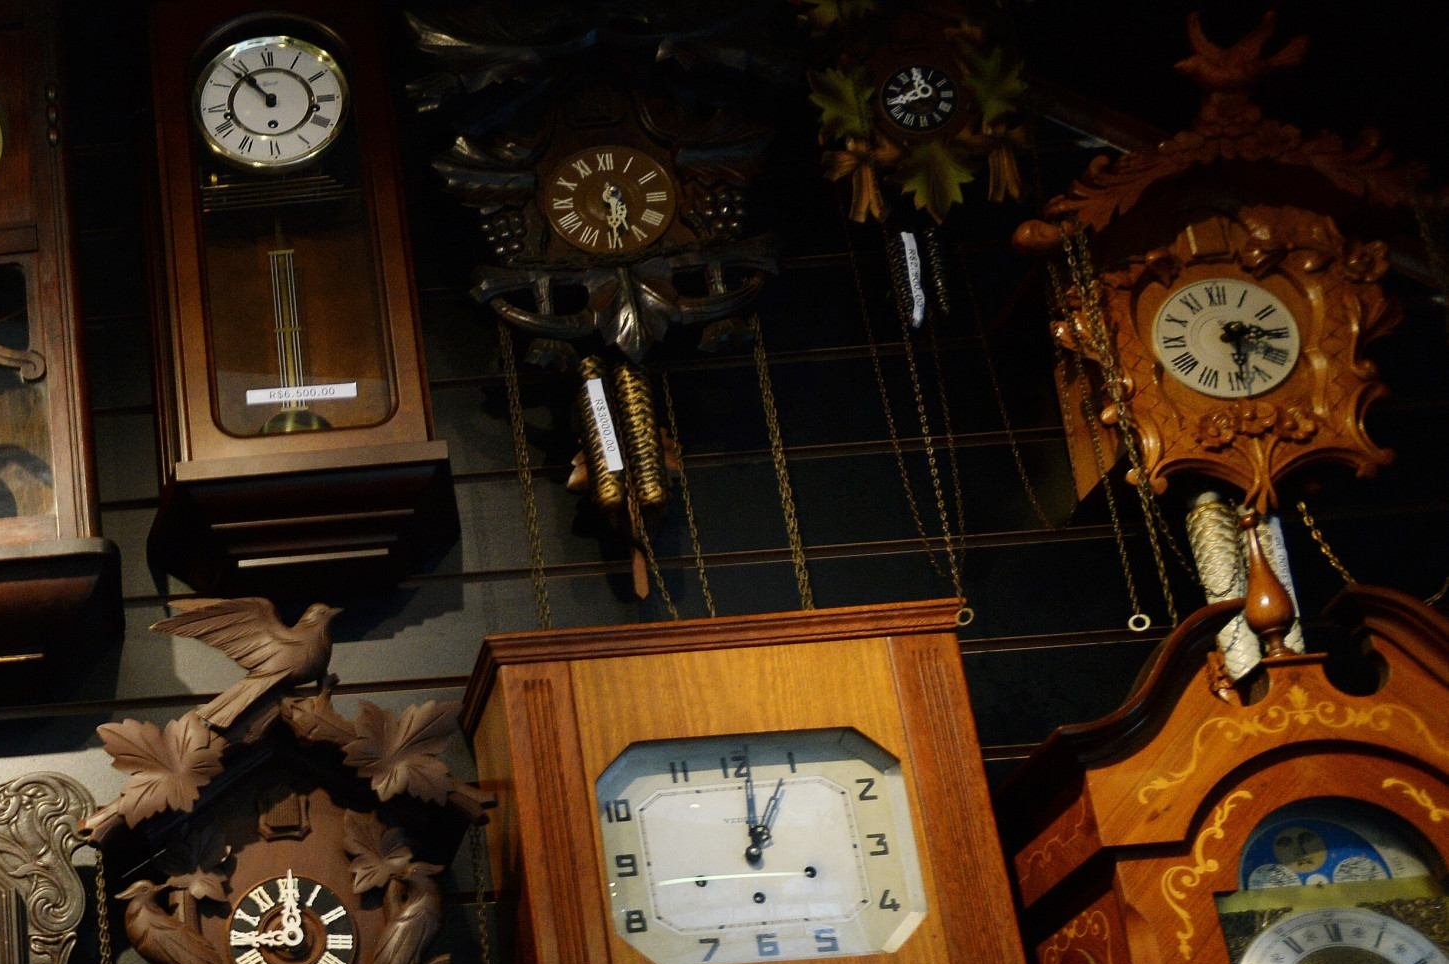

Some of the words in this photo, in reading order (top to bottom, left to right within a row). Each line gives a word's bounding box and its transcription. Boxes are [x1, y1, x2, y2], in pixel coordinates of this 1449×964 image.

[596, 153, 614, 171] XII
[623, 156, 634, 174] I
[638, 171, 658, 185] II
[1180, 293, 1202, 314] XI
[1206, 286, 1226, 305] XII
[1255, 305, 1275, 320] II
[670, 761, 688, 783] 11
[721, 756, 750, 778] 12
[787, 753, 796, 773] 1
[856, 778, 877, 800] 2
[606, 800, 631, 822] 10
[868, 834, 888, 856] 3
[616, 855, 637, 877] 9
[880, 890, 900, 910] 4
[320, 905, 346, 925] II
[626, 911, 646, 933] 8
[327, 934, 353, 950] III
[700, 938, 718, 961] 7
[757, 932, 780, 955] 6
